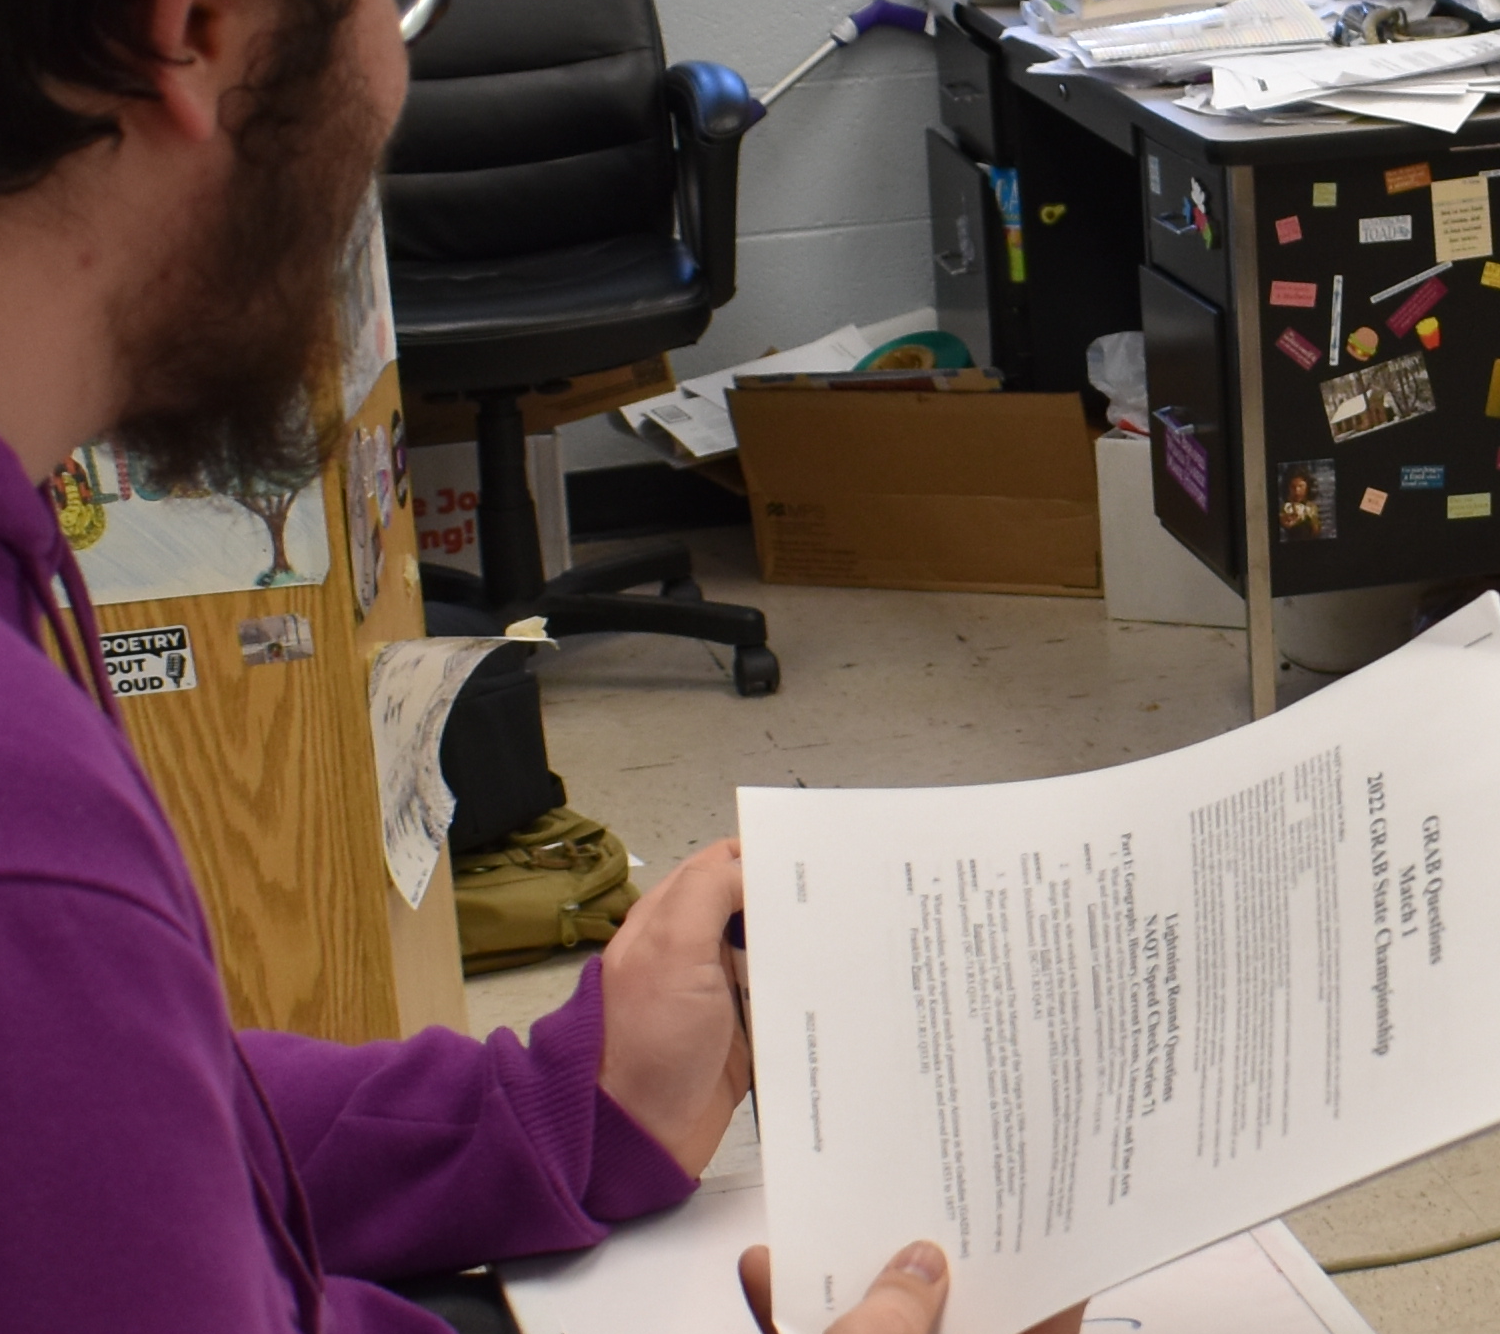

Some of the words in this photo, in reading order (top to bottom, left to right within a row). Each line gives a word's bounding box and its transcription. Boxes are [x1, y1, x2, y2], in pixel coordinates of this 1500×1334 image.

[437, 487, 479, 515] Jo
[419, 519, 475, 555] ng!
[99, 630, 182, 655] POETRY
[106, 657, 147, 676] OUT
[112, 675, 164, 695] OUD
[1368, 772, 1384, 814] 2022
[1122, 833, 1132, 857] Part
[1370, 818, 1388, 876] GRAB
[1422, 815, 1442, 874] GRAB
[796, 862, 806, 903] 2/26/2022
[1373, 879, 1390, 923] State
[1399, 865, 1417, 923] Match
[935, 894, 943, 915] What
[1125, 872, 1137, 935] Geography,
[1424, 877, 1445, 965] Questions
[910, 928, 920, 962] Franklin
[1143, 914, 1159, 959] NAQT
[1164, 913, 1179, 984] Lightning
[1402, 928, 1418, 937] 1
[1128, 937, 1139, 980] History,
[1131, 983, 1140, 1025] Current
[1144, 964, 1160, 1007] Speed
[1372, 927, 1394, 1057] Championship
[806, 1011, 815, 1031] 2022
[1167, 985, 1180, 1033] Round
[806, 1034, 818, 1063] GRAB
[1130, 1029, 1141, 1067] Events,
[1146, 1010, 1160, 1055] Check
[810, 1066, 819, 1087] State
[935, 1073, 945, 1087] Act
[1144, 1057, 1158, 1097] Series
[1163, 1035, 1179, 1102] Questions
[937, 1090, 946, 1106] and
[1126, 1069, 1139, 1123] Literature,
[1142, 1099, 1156, 1116] 71
[810, 1090, 824, 1152] Championship
[938, 1109, 948, 1135] served
[1125, 1125, 1134, 1144] and
[941, 1138, 950, 1158] from
[1122, 1147, 1133, 1170] Fine
[1121, 1173, 1131, 1197] Arts
[825, 1275, 835, 1305] Match
